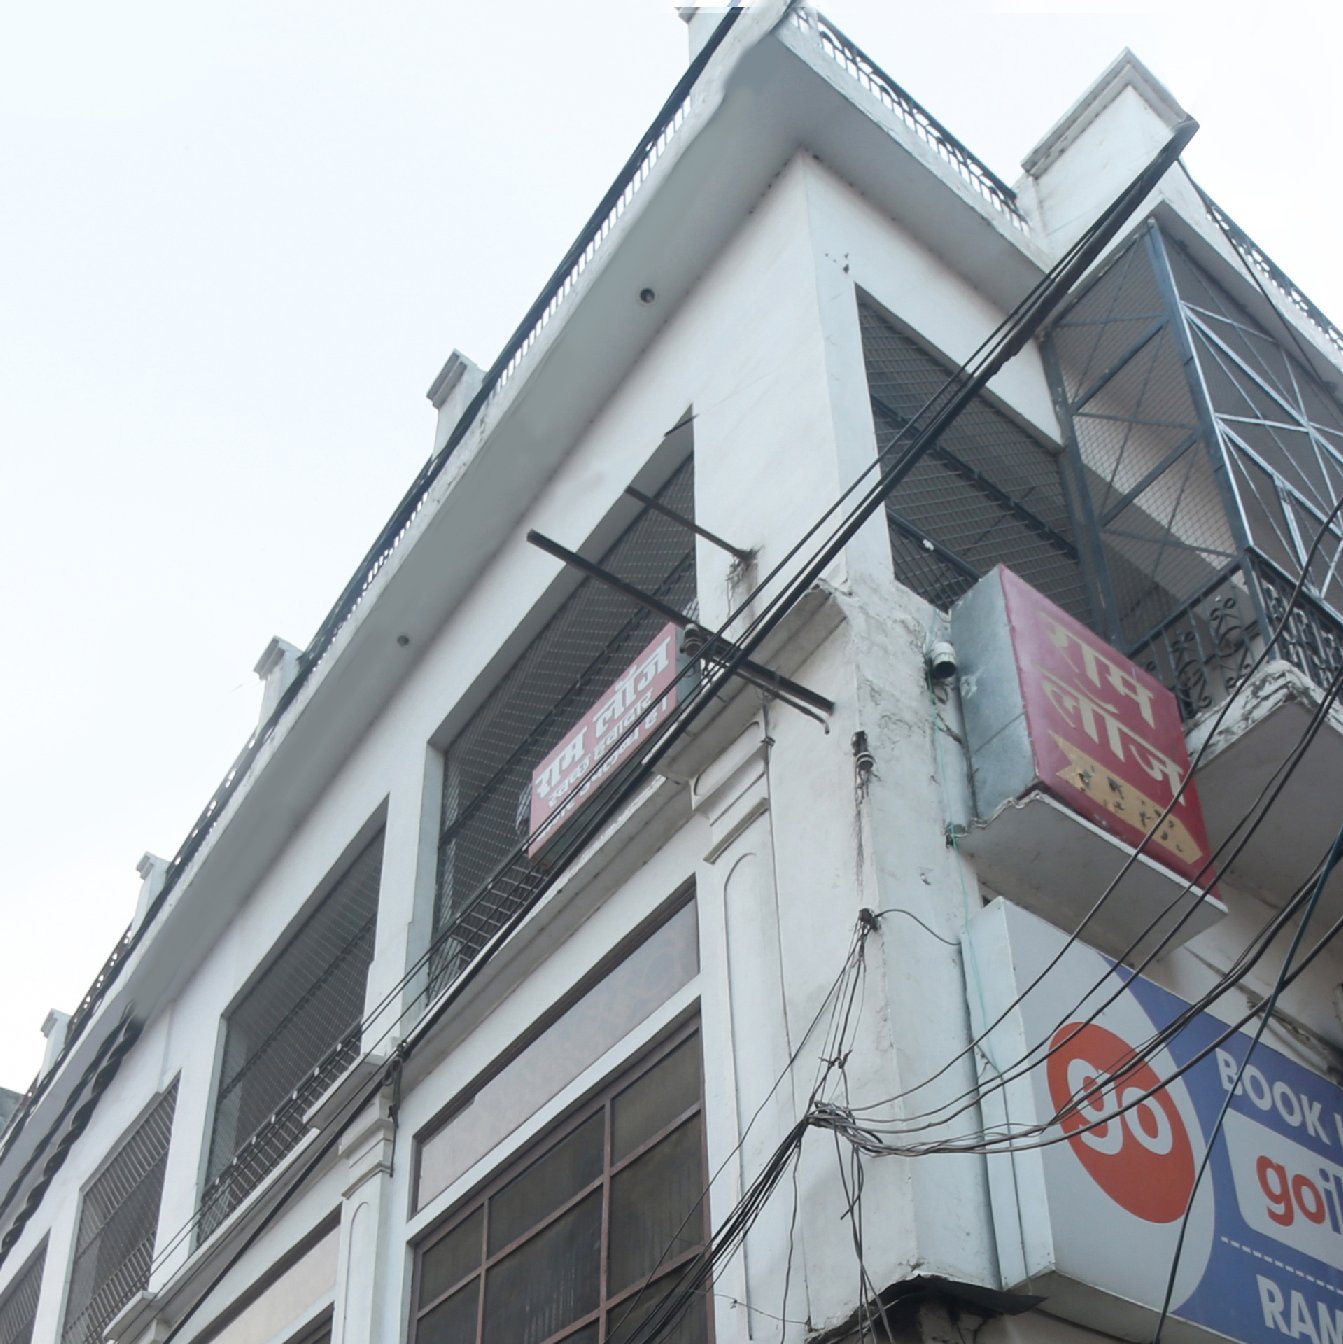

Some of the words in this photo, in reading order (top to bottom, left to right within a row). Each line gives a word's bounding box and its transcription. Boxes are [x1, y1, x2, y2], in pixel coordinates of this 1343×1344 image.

[535, 726, 587, 798] राम
[592, 636, 672, 739] लॉज
[1036, 610, 1156, 729] राम
[1034, 662, 1186, 806] लॉज
[1066, 1056, 1174, 1156] go
[1216, 1048, 1331, 1146] BOOK
